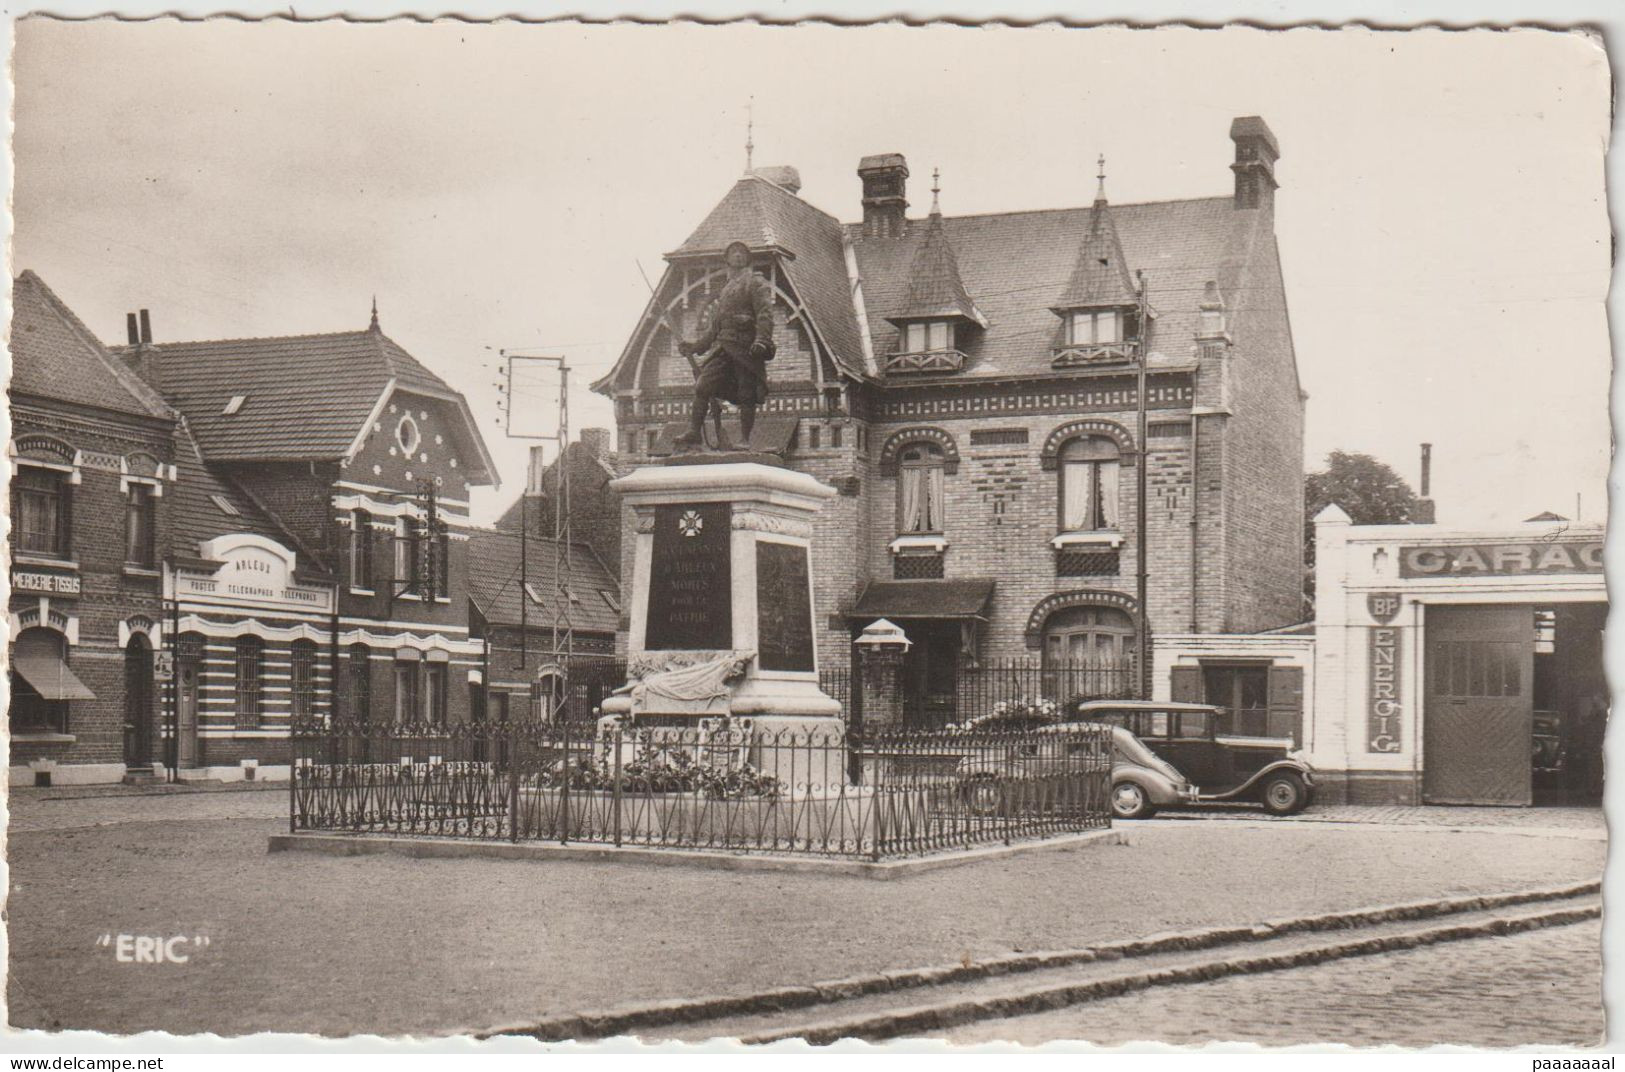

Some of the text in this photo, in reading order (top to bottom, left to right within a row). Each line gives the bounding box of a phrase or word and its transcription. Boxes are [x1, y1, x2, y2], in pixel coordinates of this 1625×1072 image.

[236, 559, 271, 574] ARLEUX
[191, 581, 216, 592] POSTES
[1374, 598, 1398, 615] BP
